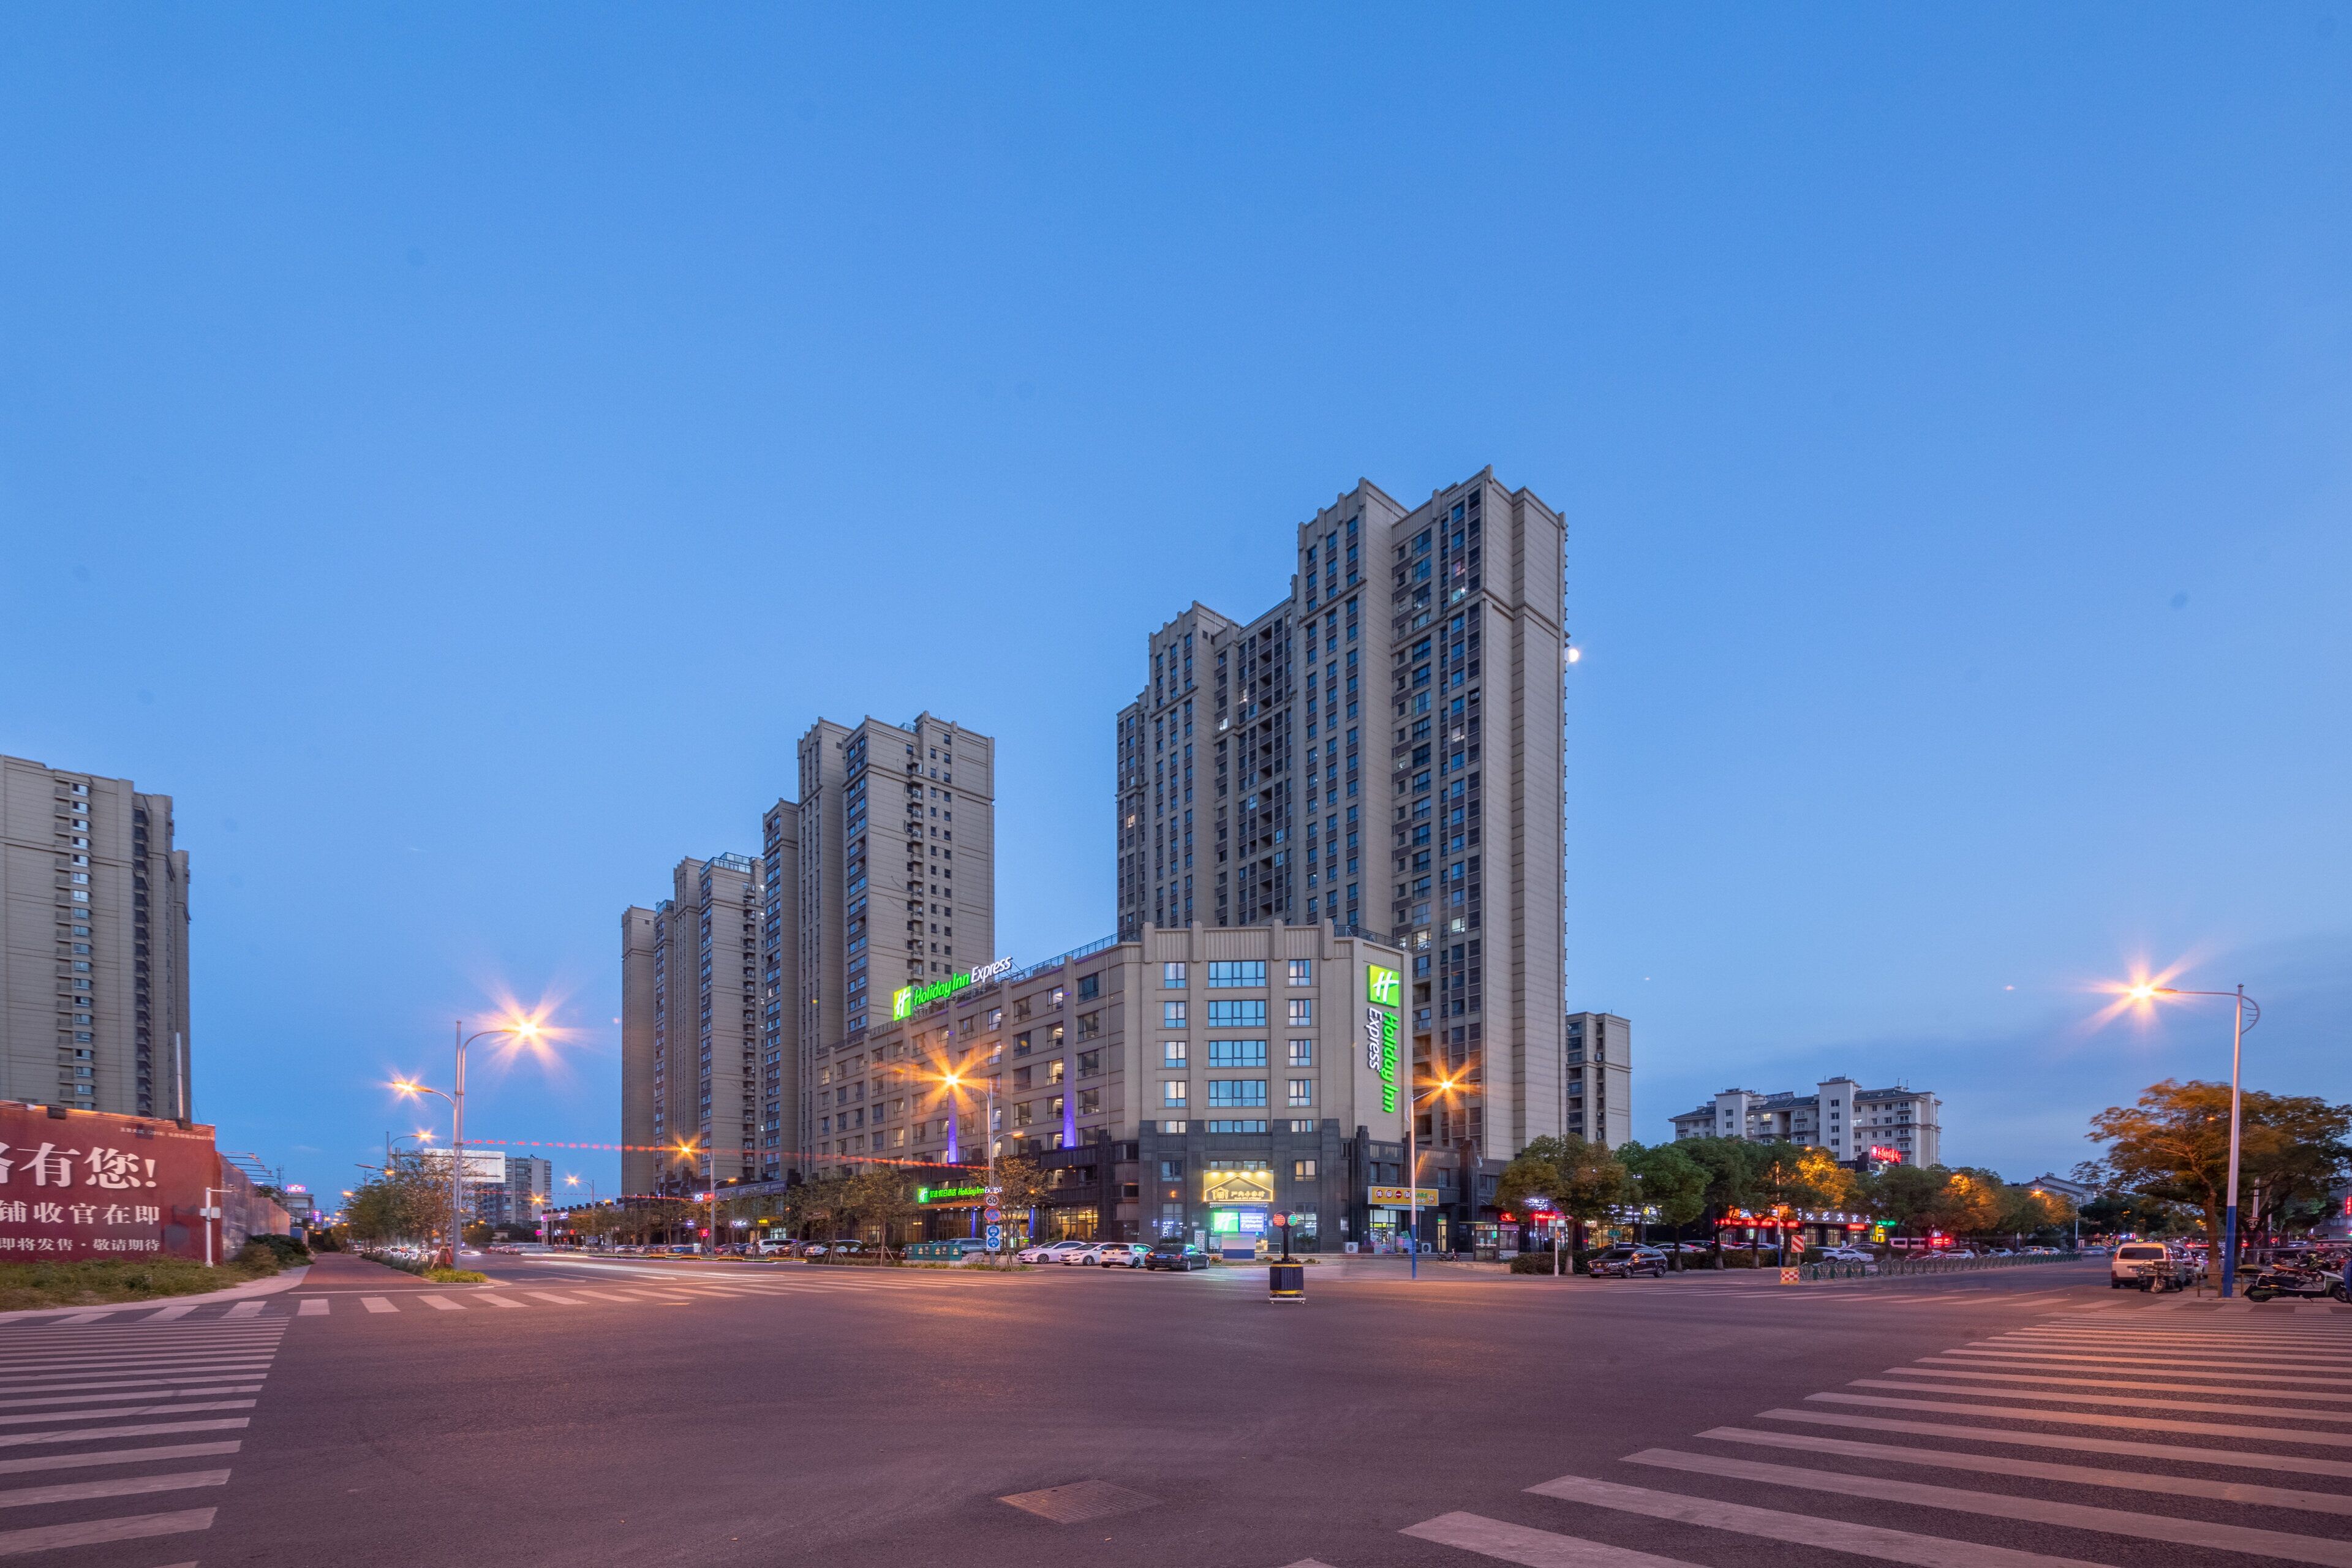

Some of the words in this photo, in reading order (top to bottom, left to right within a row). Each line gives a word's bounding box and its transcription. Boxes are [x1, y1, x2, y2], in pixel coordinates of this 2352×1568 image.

[914, 981, 952, 1006] Holiday
[952, 973, 970, 990] Inn
[971, 956, 1011, 982] Express
[1366, 1007, 1382, 1070] Express
[1381, 1012, 1399, 1082] Holiday
[1382, 1084, 1399, 1112] Inn
[0, 1142, 157, 1189] 有您!
[958, 1187, 976, 1196] Holiday
